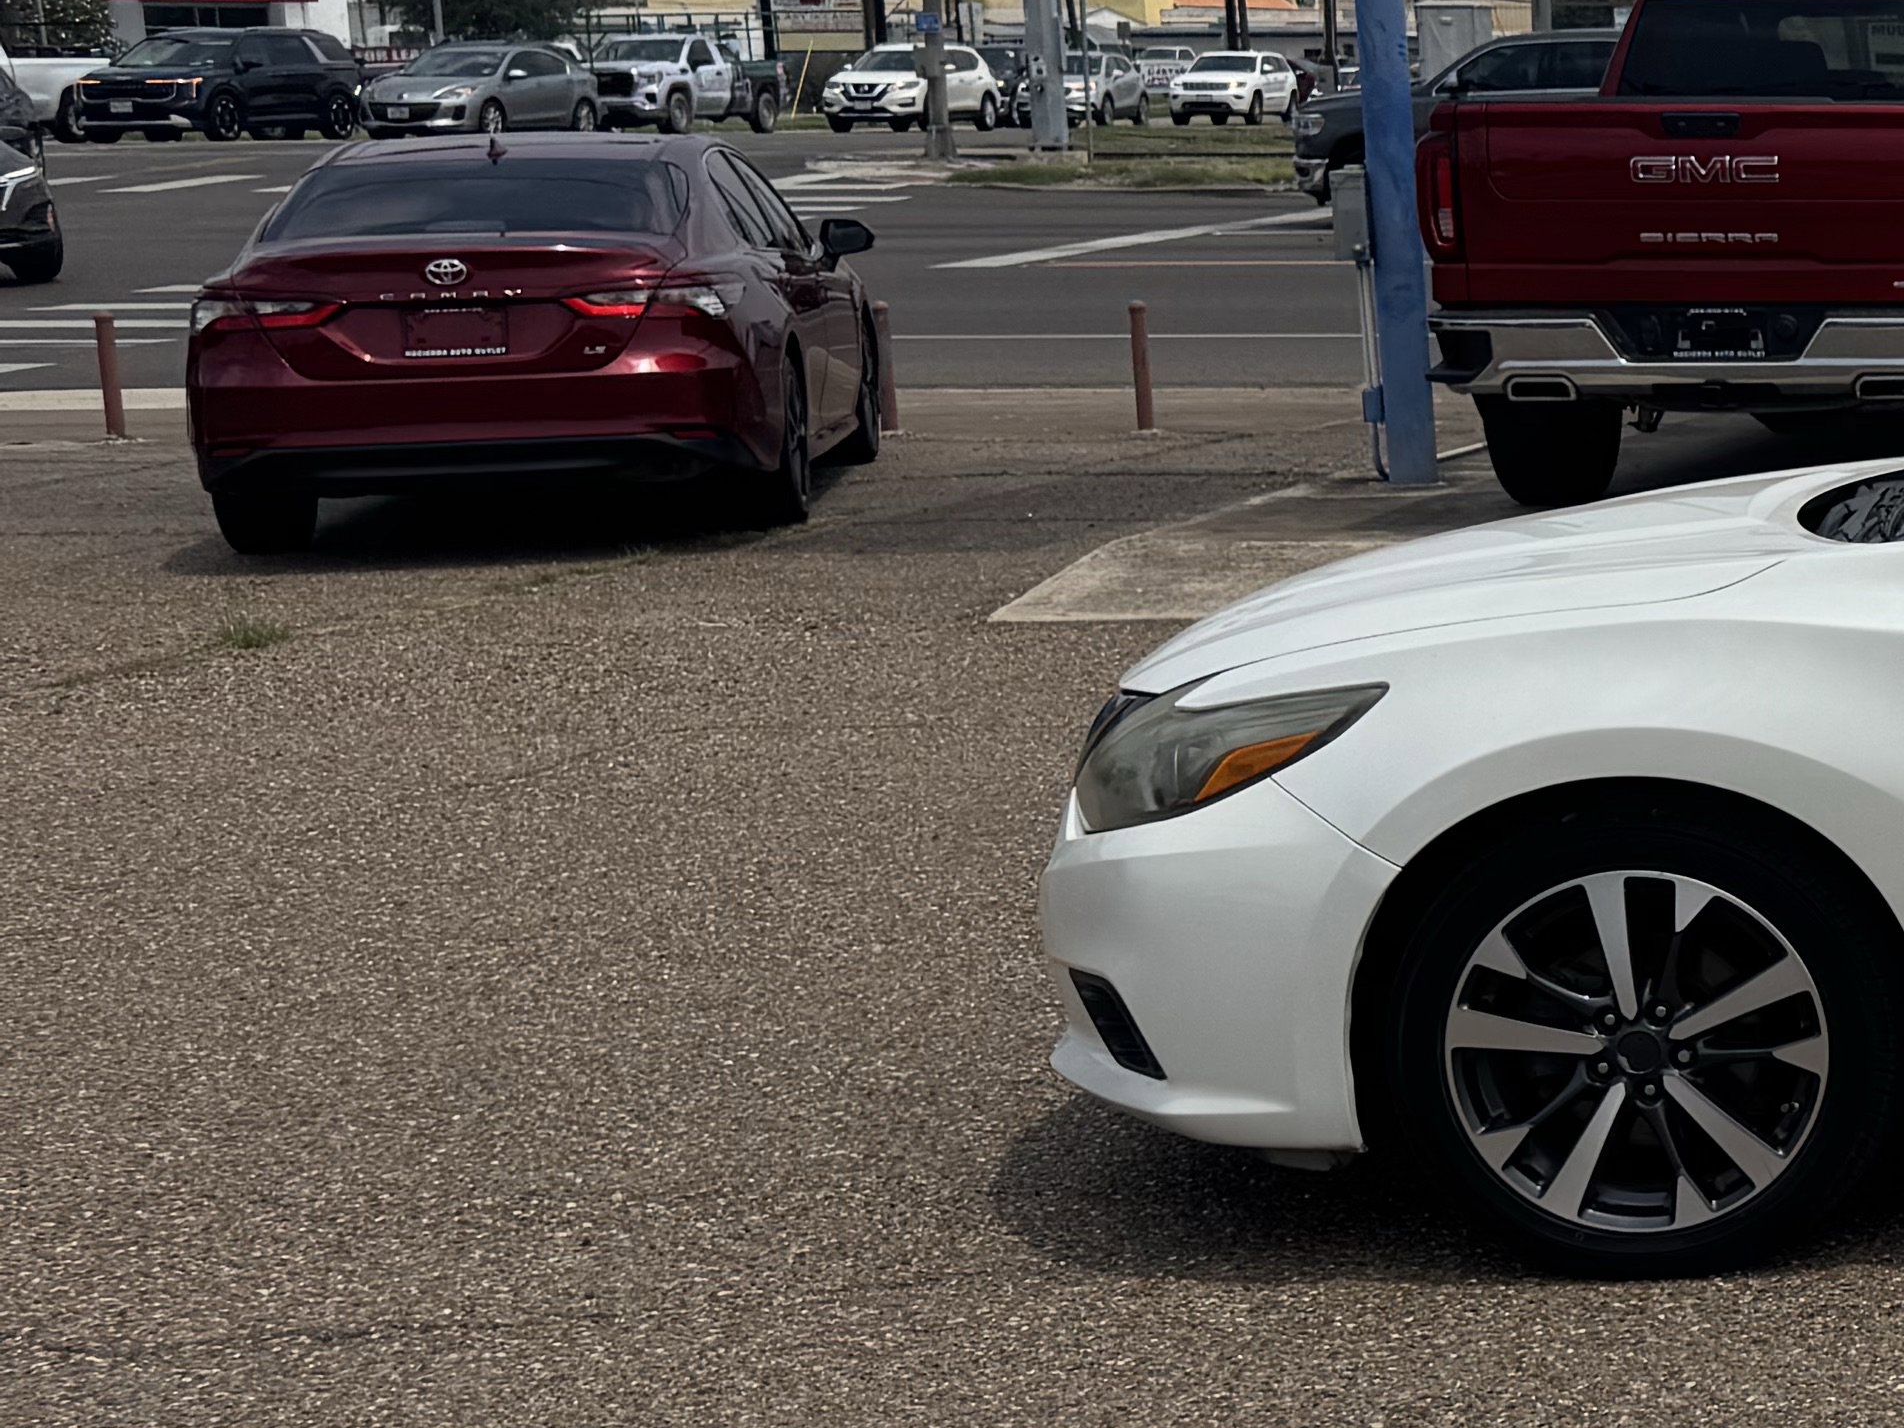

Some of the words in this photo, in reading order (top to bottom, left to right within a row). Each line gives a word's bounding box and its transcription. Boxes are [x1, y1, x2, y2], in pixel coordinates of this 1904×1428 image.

[1629, 155, 1780, 184] GMC
[1640, 232, 1779, 244] SIERRA
[379, 288, 522, 301] CAMRY
